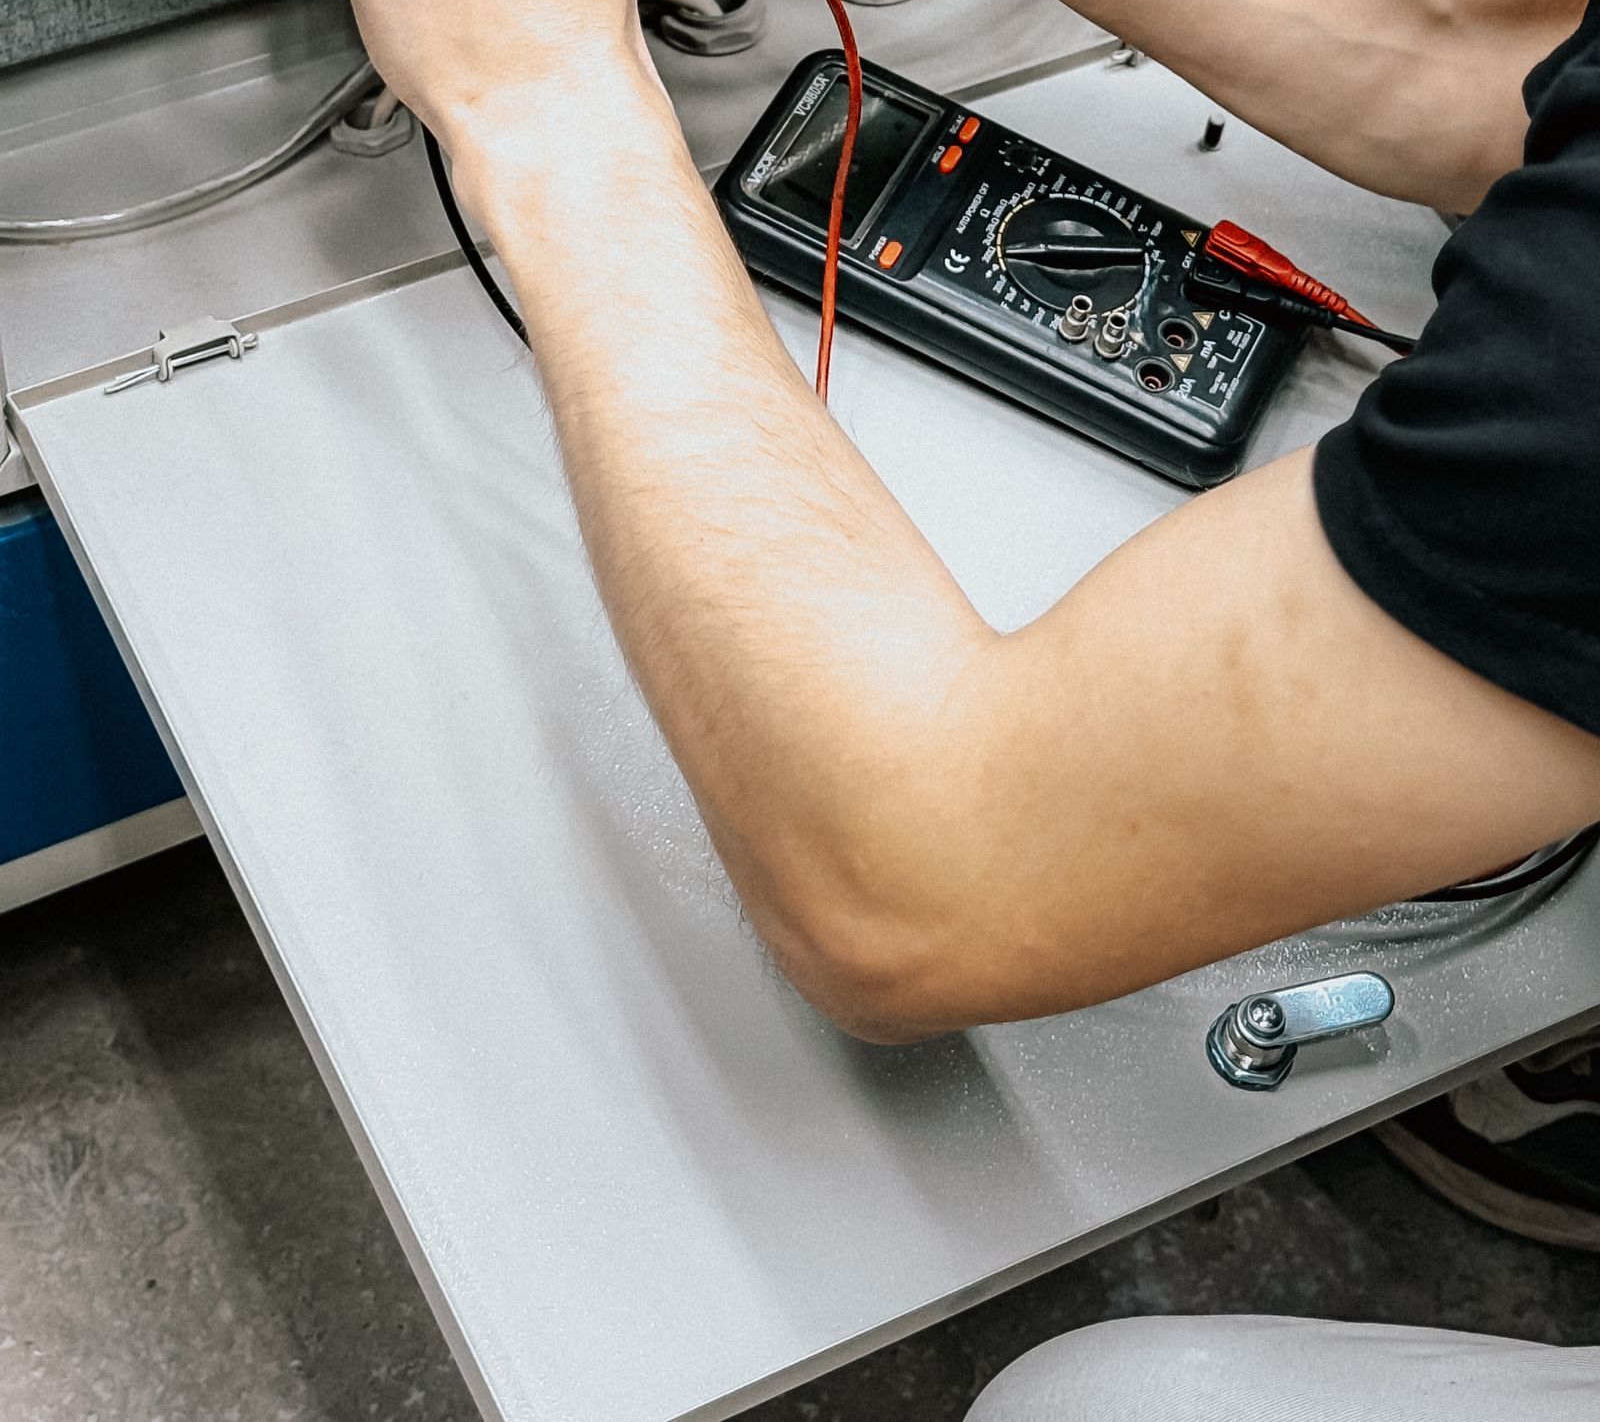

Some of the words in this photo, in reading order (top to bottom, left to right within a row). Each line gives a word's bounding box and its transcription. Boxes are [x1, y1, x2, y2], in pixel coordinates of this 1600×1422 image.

[956, 215, 970, 235] AUTO
[968, 193, 983, 218] POWER
[978, 182, 990, 196] OFF
[1150, 220, 1163, 237] TEMP
[868, 235, 888, 261] POWER
[944, 248, 971, 274] CE
[1181, 255, 1193, 269] CAT
[1200, 340, 1216, 360] mA
[1176, 377, 1197, 399] 20A
